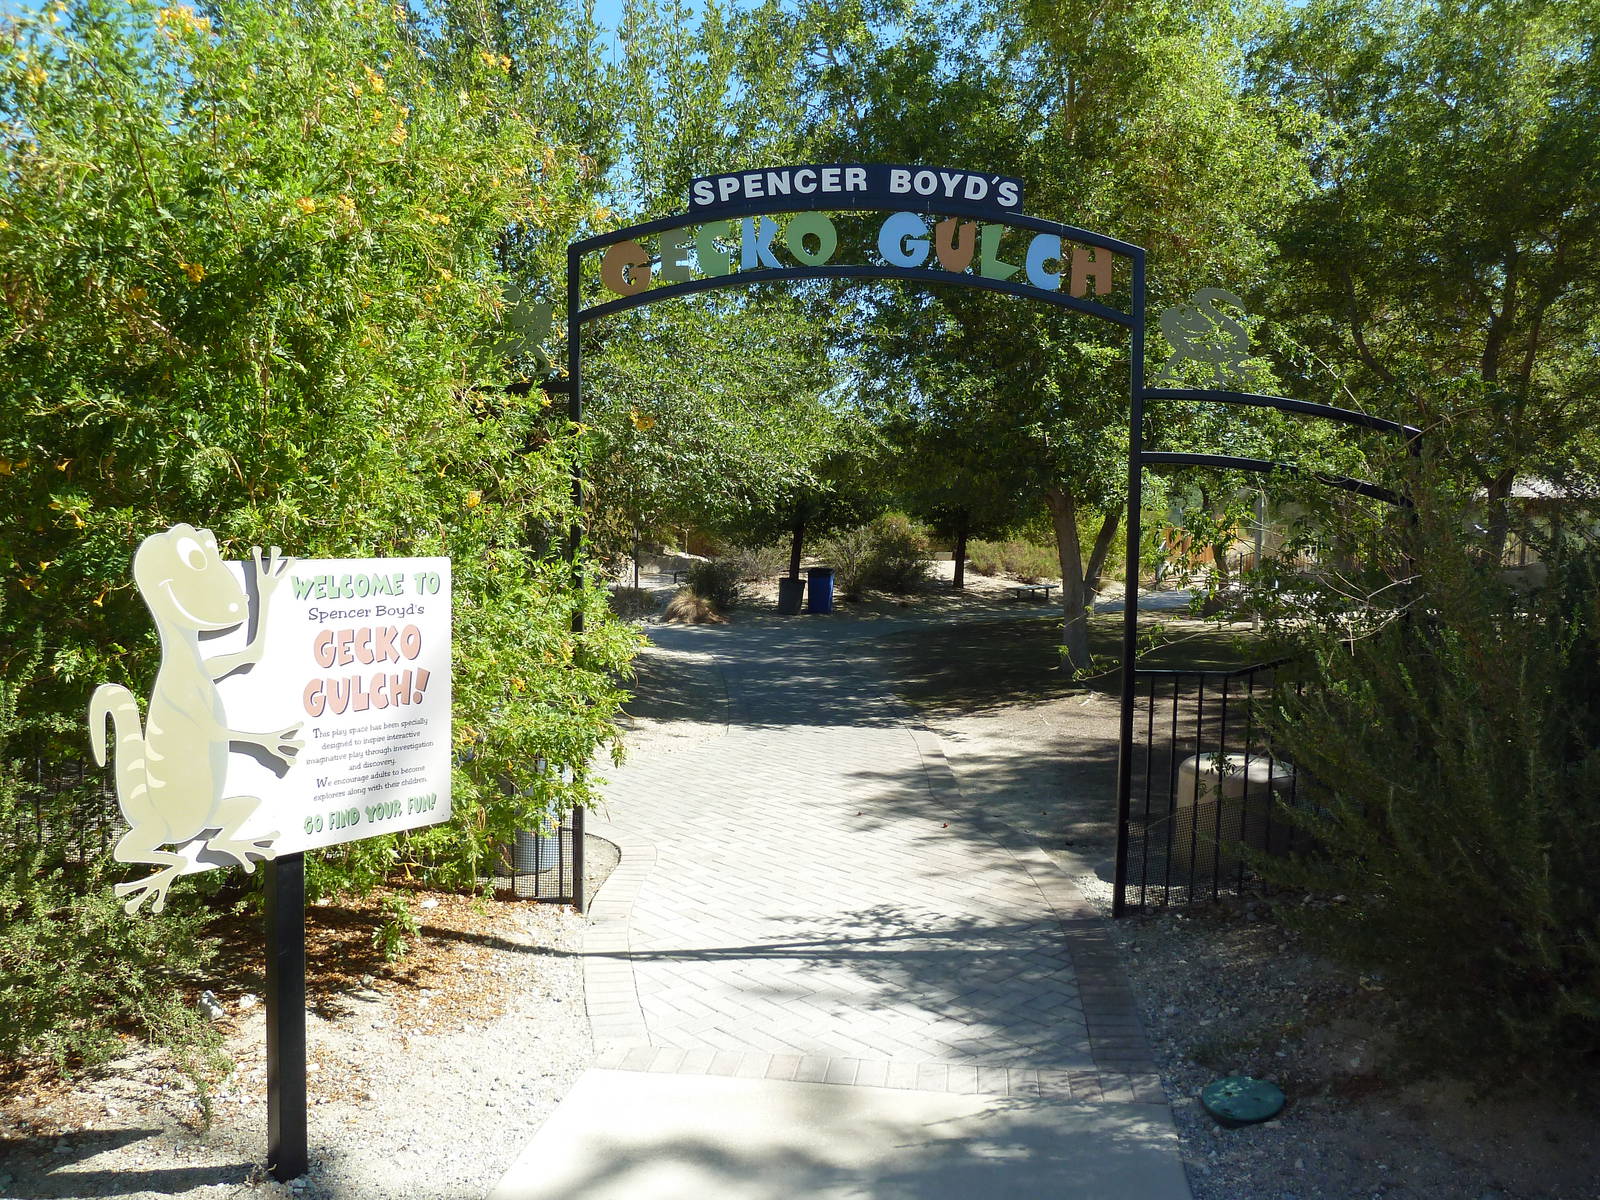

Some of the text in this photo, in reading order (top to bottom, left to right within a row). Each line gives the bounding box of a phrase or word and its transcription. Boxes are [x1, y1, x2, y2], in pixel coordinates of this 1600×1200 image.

[693, 167, 1019, 207] SPENCER BOYD'S
[601, 211, 1112, 299] GECKO GULCH
[291, 572, 440, 600] WELCOME TO
[308, 604, 424, 623] Spencer Boyd's
[314, 625, 422, 668] GECKO
[303, 668, 430, 717] GULCH!
[313, 728, 330, 738] This
[332, 730, 348, 738] play
[349, 726, 368, 735] space
[401, 718, 428, 728] specially
[322, 739, 352, 750] designed
[363, 736, 386, 746] inspire
[387, 731, 420, 740] interactive
[306, 740, 433, 765] imaginative play through investigation
[349, 759, 396, 770] and discovery.
[316, 777, 332, 788] We
[334, 774, 369, 785] encourage
[371, 771, 391, 779] adults
[401, 766, 425, 774] become
[314, 791, 345, 802] explorers
[348, 787, 366, 796] along
[304, 793, 437, 834] GO FIND YOUR FUN!
